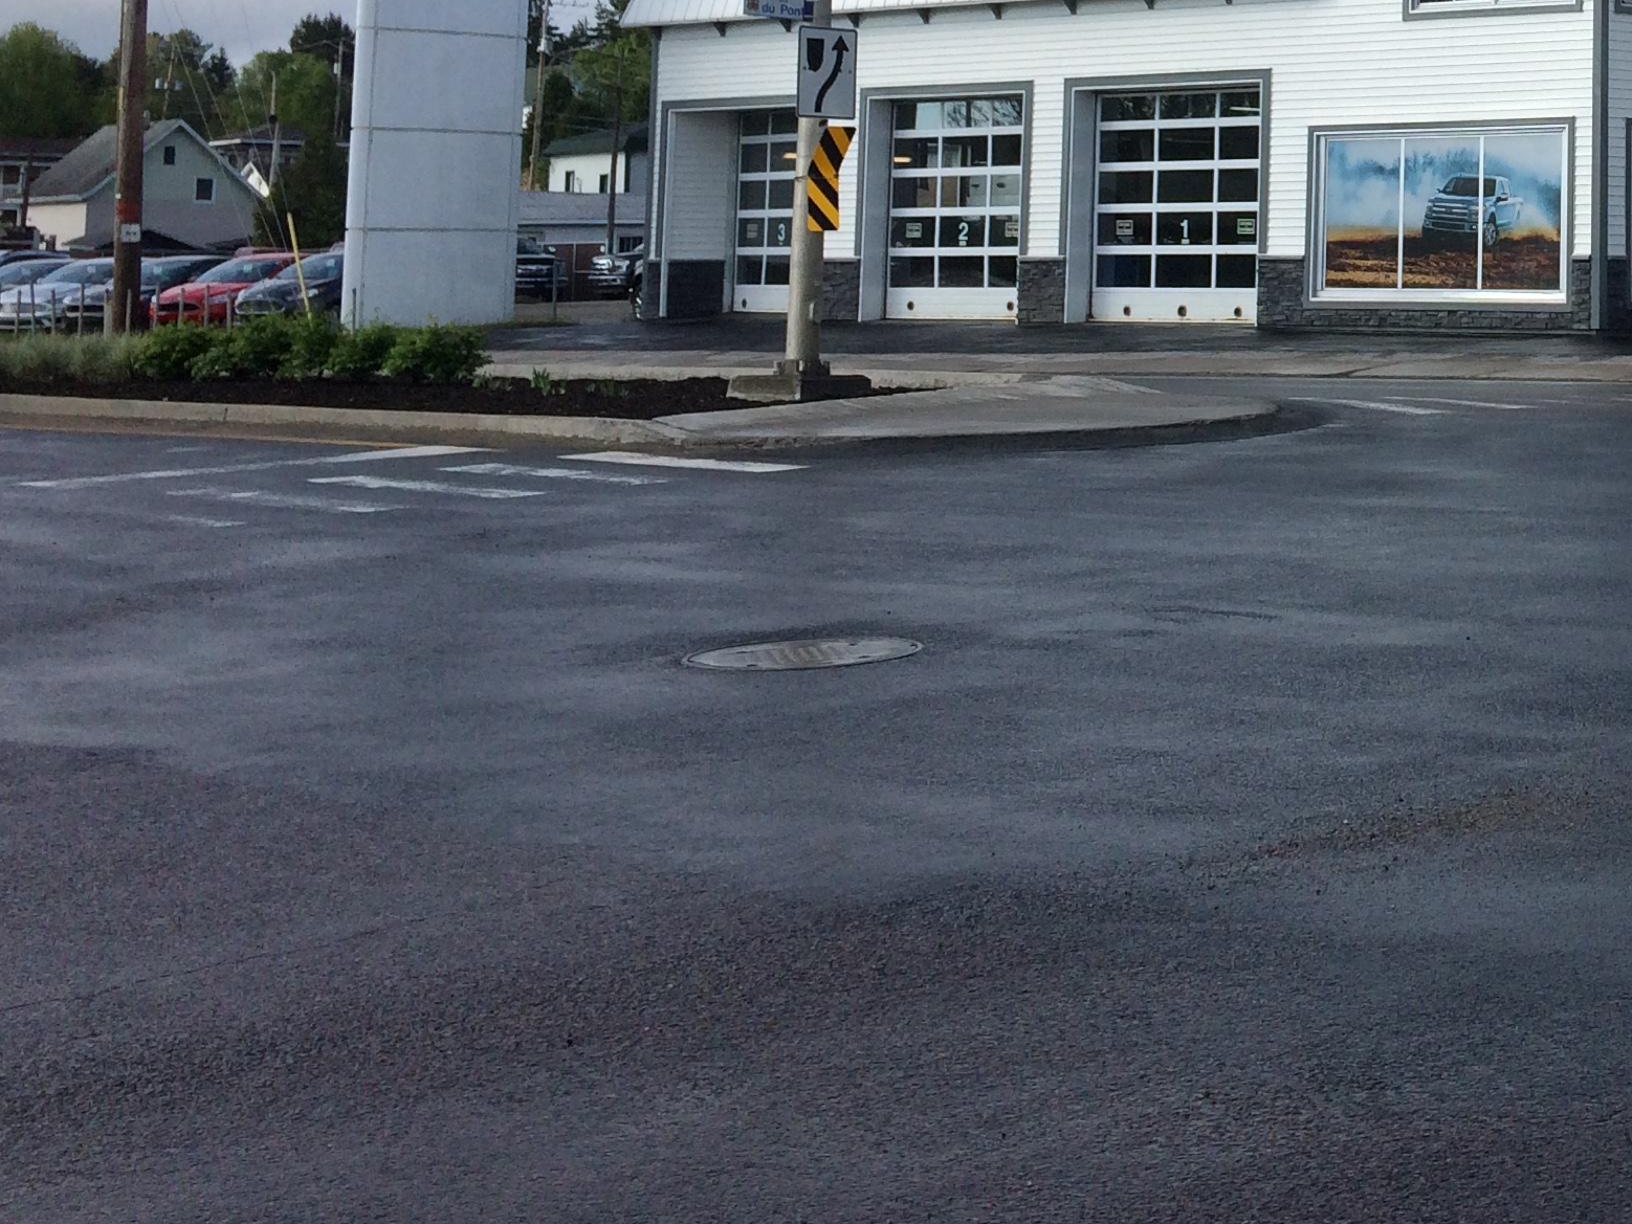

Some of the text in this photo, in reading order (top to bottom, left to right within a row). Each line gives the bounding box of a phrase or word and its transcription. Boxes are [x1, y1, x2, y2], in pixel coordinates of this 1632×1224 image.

[762, 2, 775, 13] du
[777, 223, 786, 241] 3
[957, 222, 969, 240] 2
[1179, 218, 1189, 238] 1
